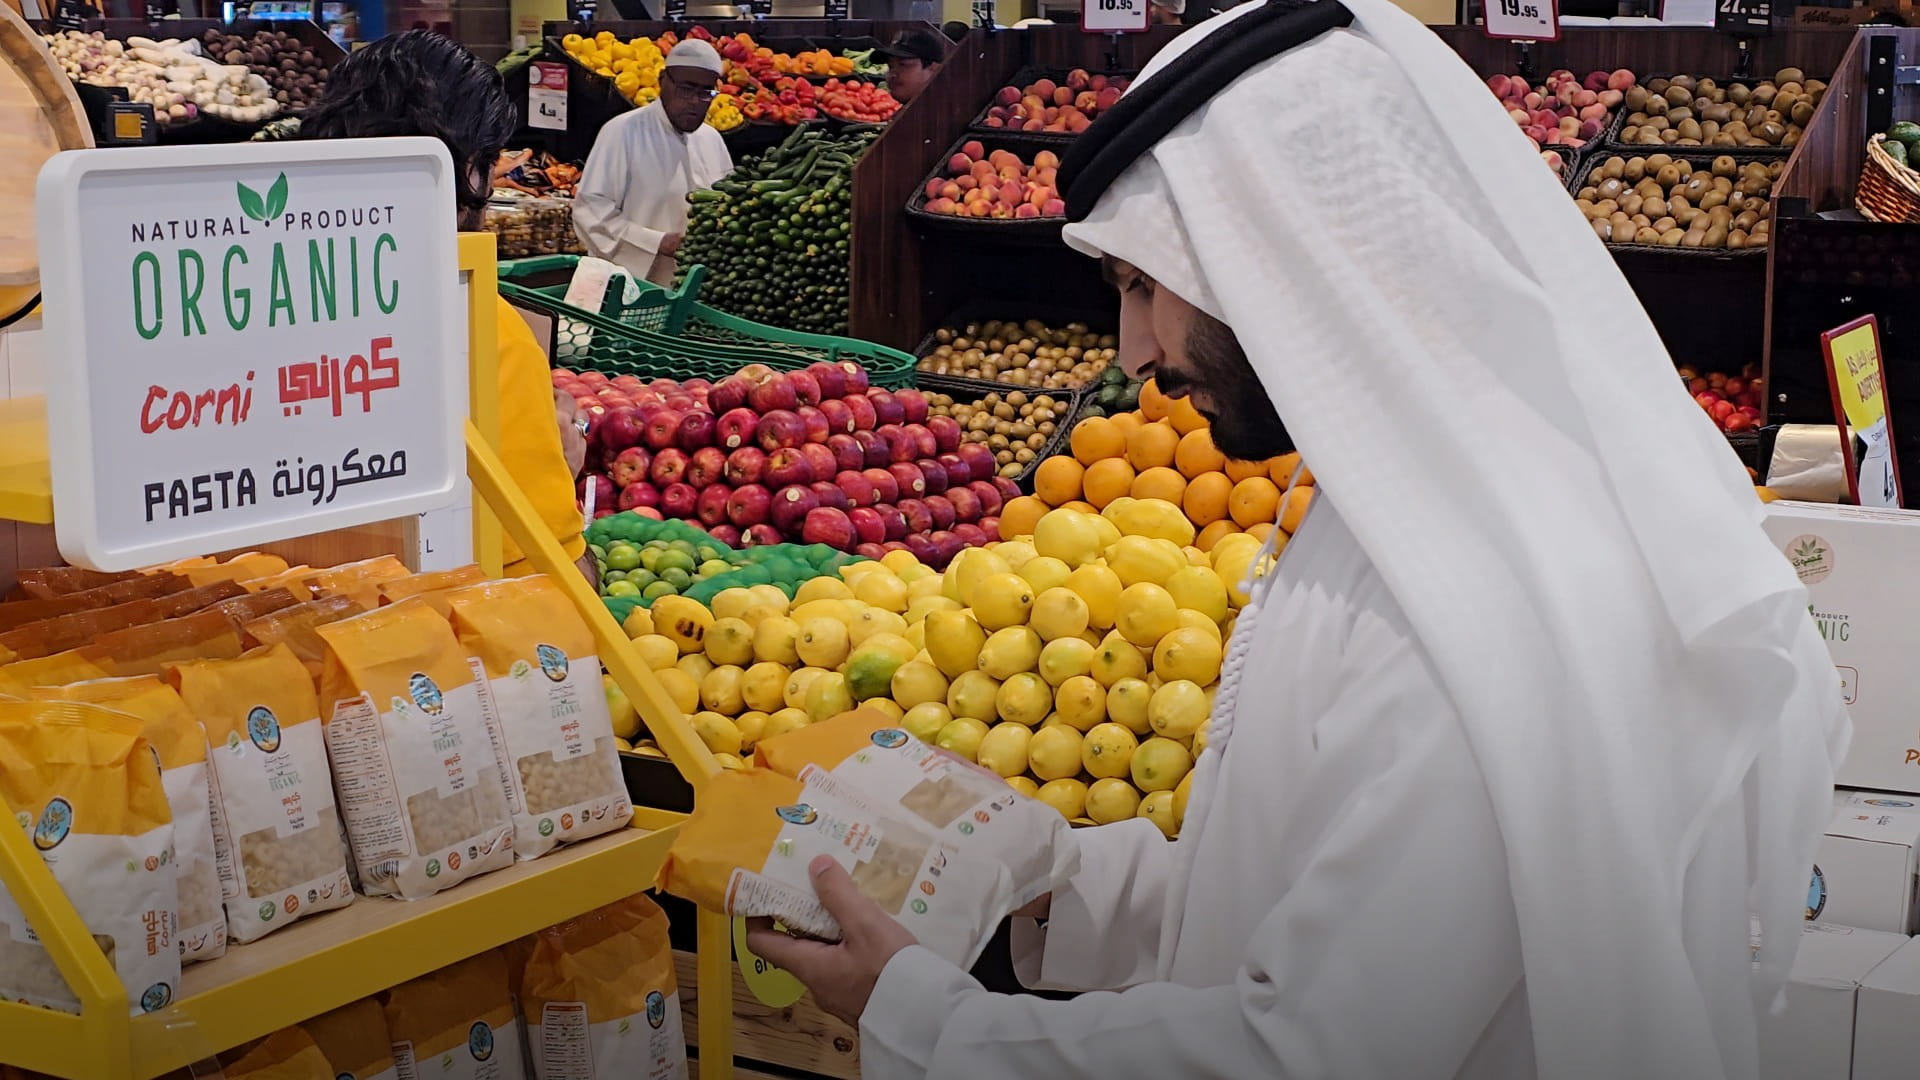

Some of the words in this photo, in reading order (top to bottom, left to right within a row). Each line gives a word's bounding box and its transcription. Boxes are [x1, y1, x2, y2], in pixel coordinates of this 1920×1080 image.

[1501, 0, 1538, 17] 19.95
[132, 217, 250, 242] NATURAL
[285, 206, 395, 231] PRODUCT
[132, 232, 399, 340] ORGANIC
[140, 370, 255, 434] Corni
[144, 468, 256, 522] PASTA
[273, 448, 407, 506] معكرونة
